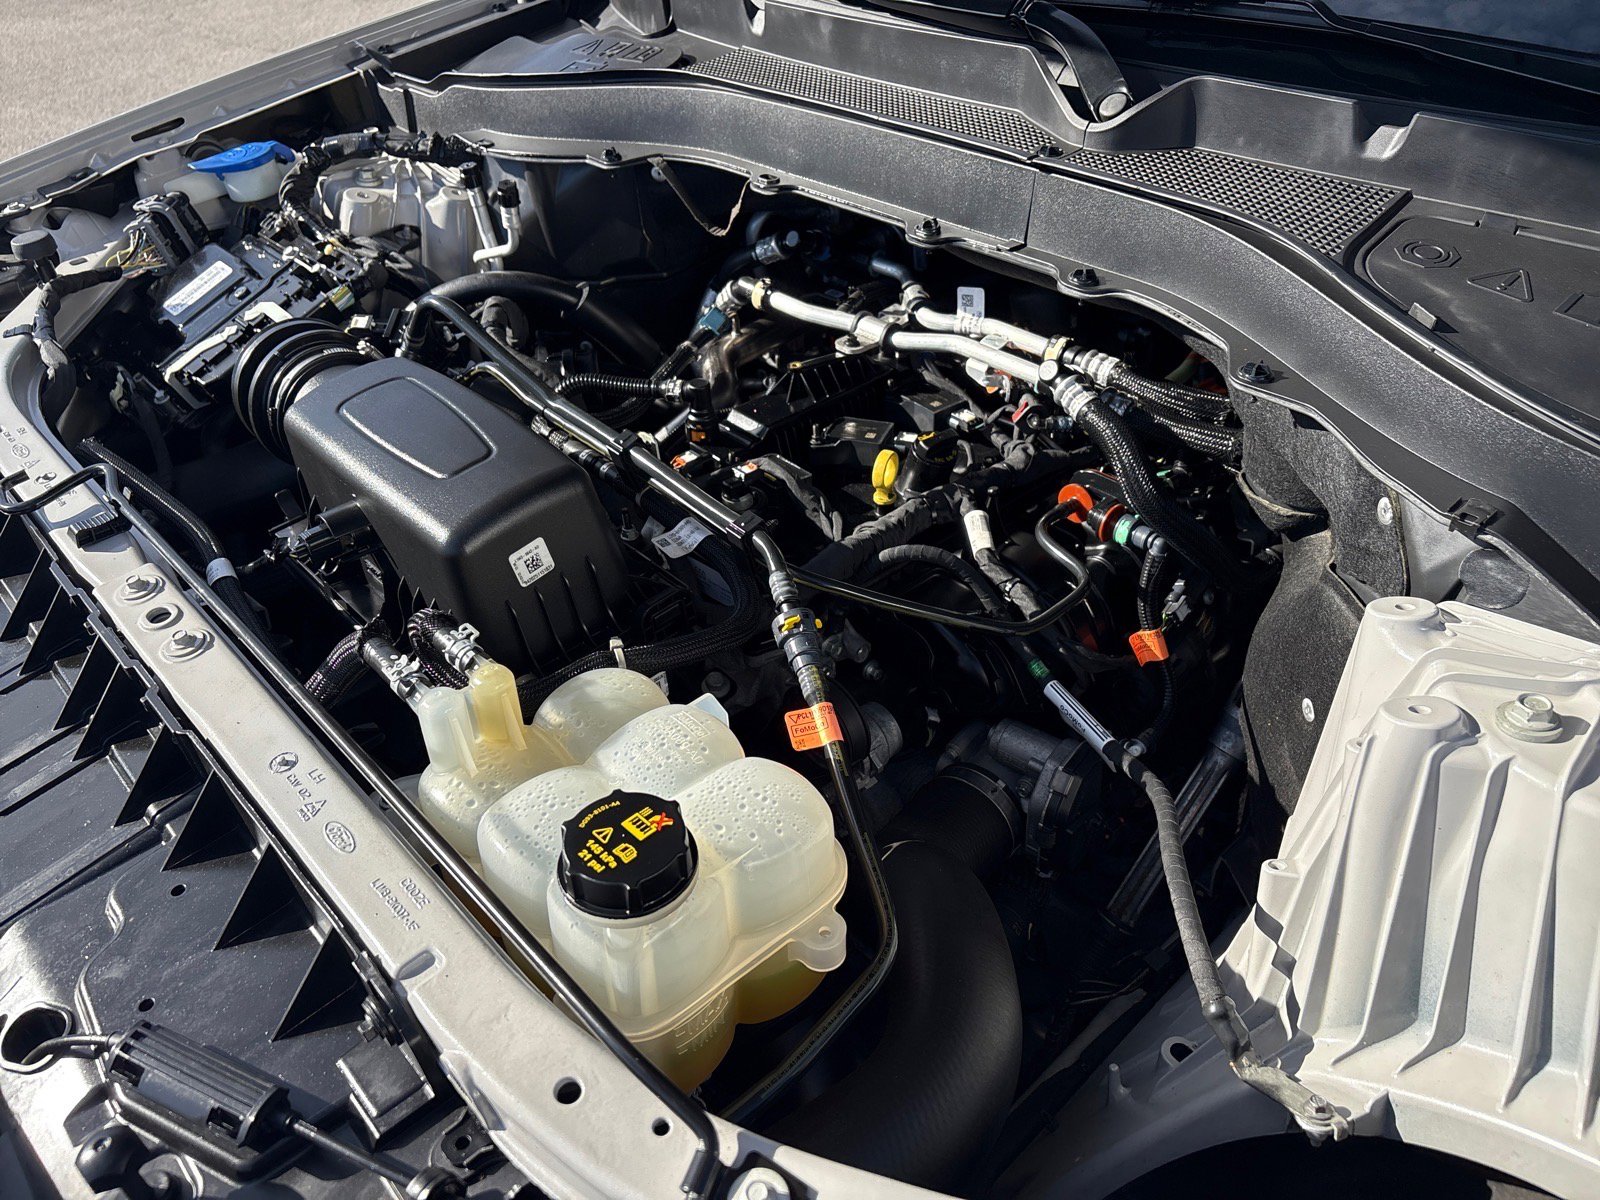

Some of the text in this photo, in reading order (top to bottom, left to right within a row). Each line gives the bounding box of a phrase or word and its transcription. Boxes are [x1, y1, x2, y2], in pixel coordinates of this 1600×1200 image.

[1060, 704, 1086, 734] FoMoCo
[307, 767, 327, 785] LH
[327, 823, 355, 852] Ford
[577, 849, 606, 873] 21 psi
[585, 839, 618, 869] 145 kPa
